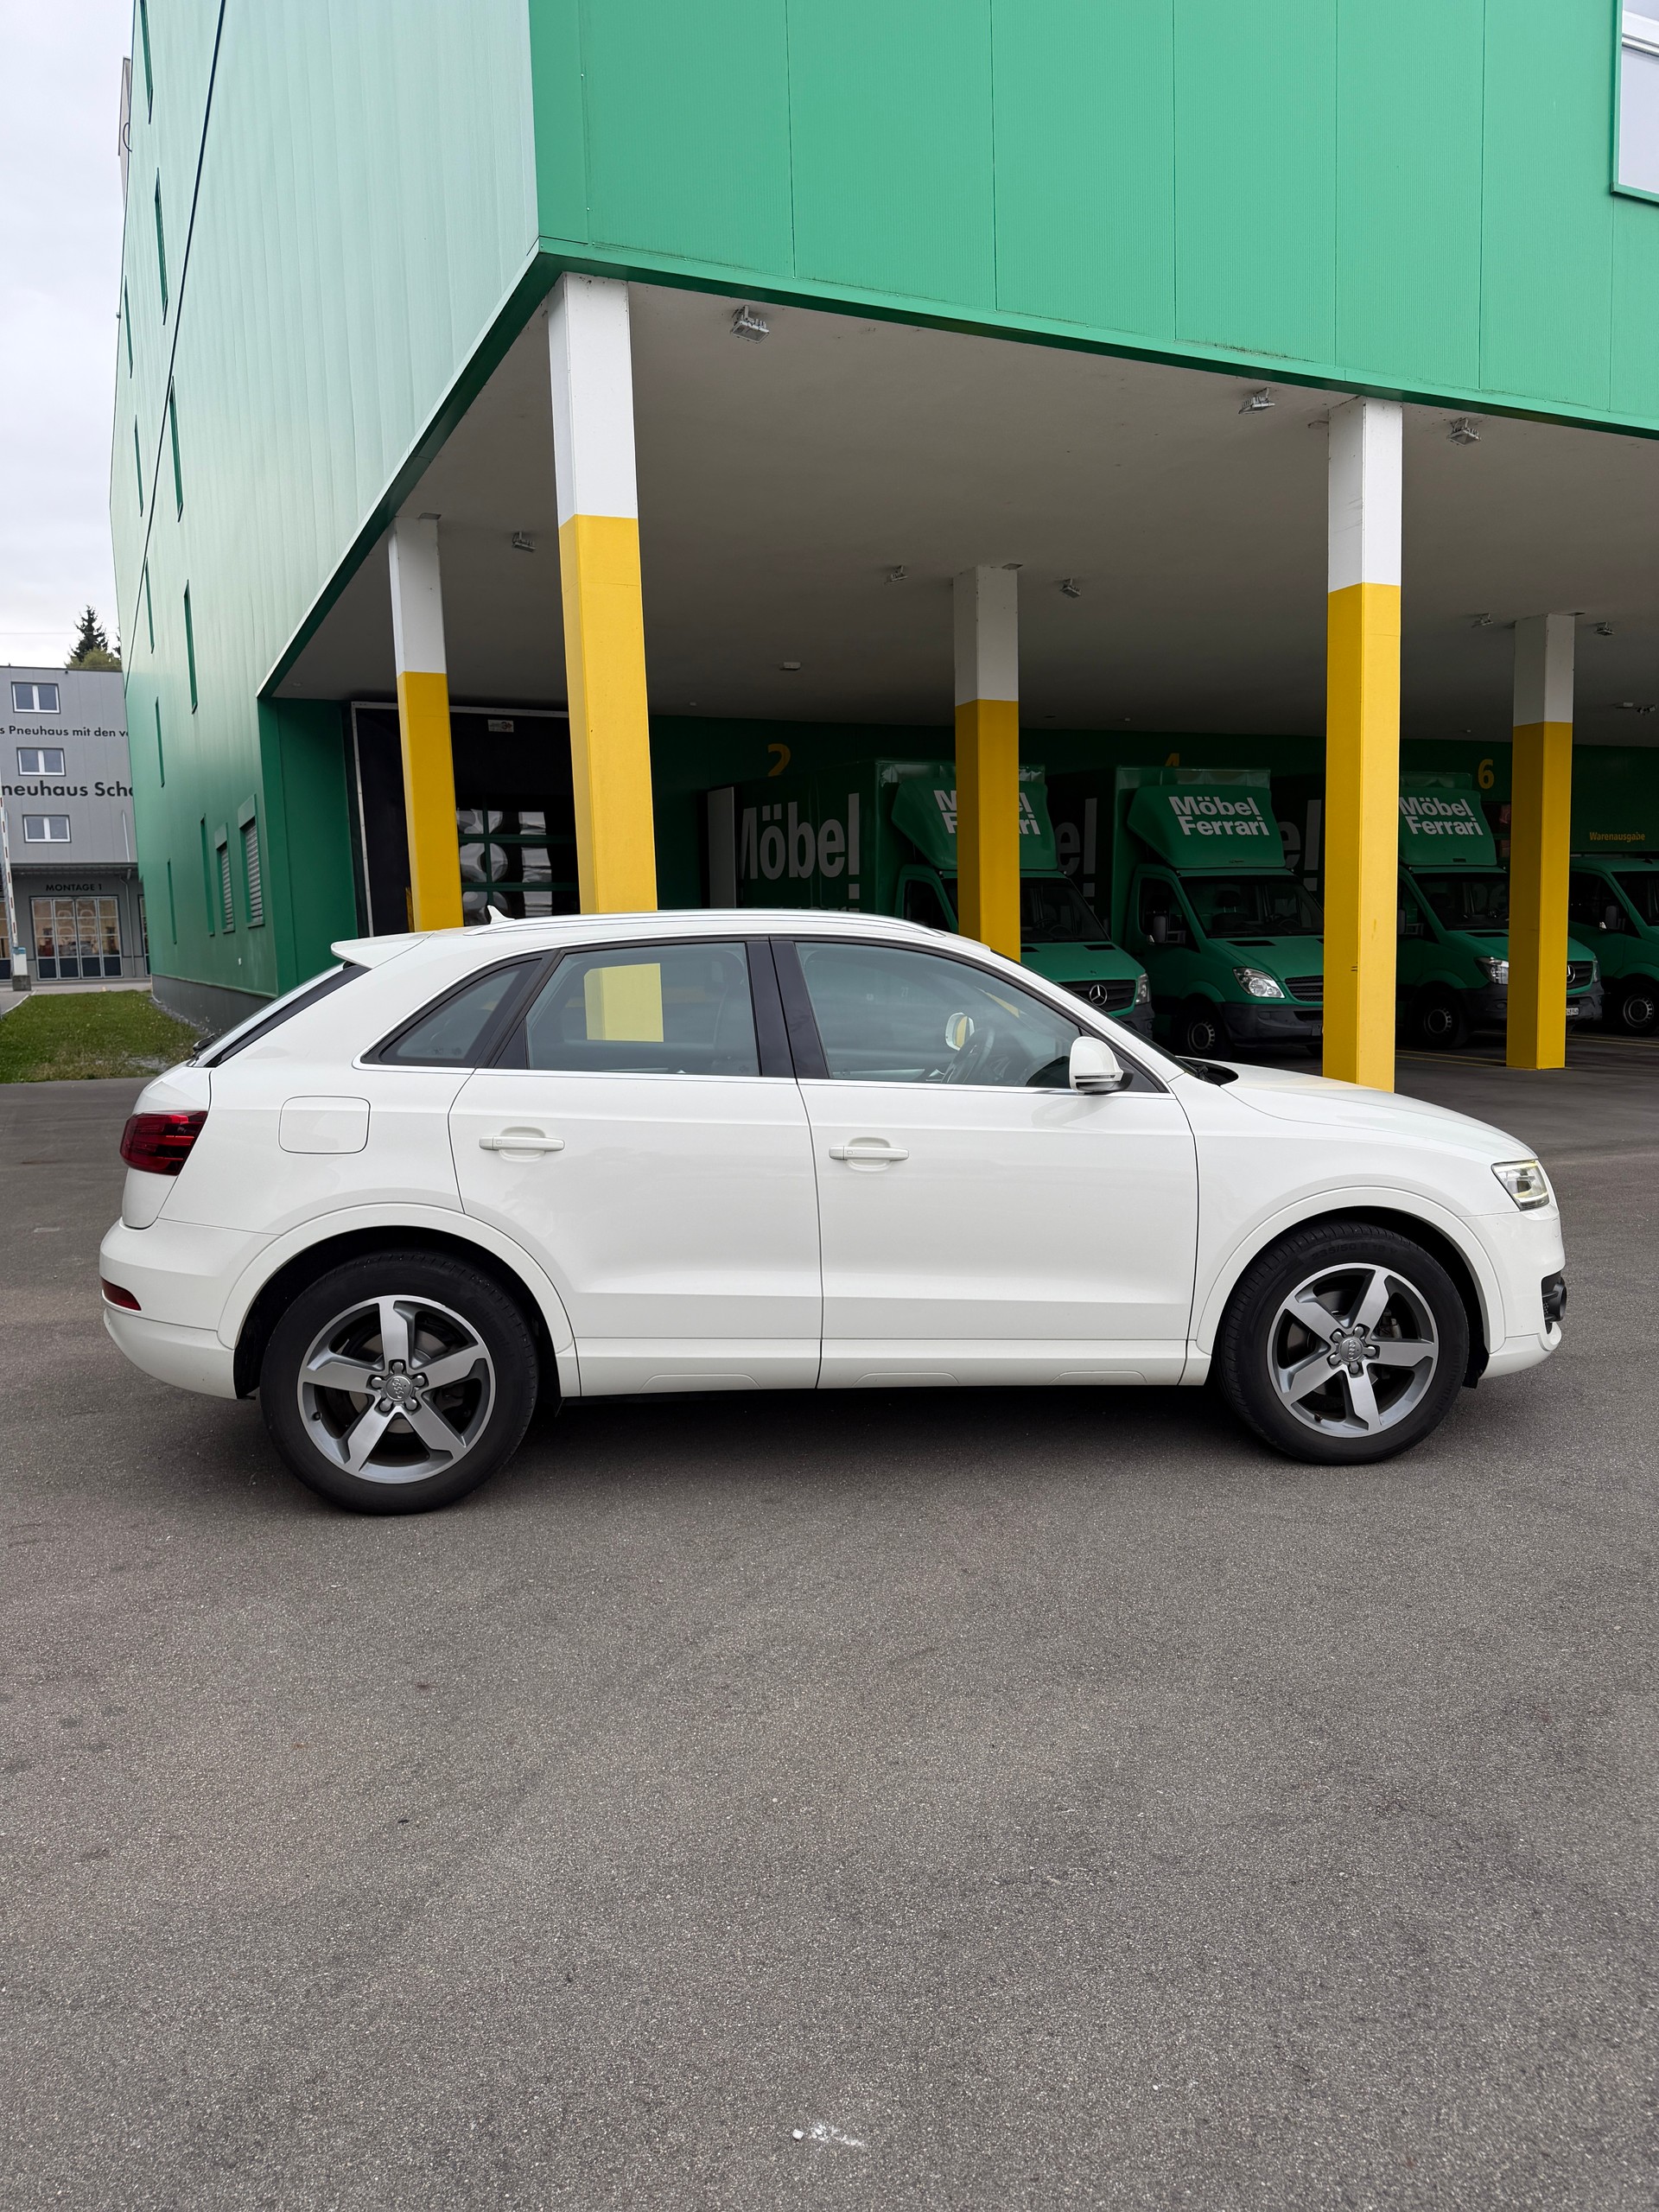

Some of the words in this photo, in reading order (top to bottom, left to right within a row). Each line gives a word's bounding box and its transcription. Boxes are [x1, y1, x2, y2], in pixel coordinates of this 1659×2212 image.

[9, 725, 69, 736] Pneuhaus
[73, 727, 91, 737] mit
[94, 728, 116, 737] den
[766, 742, 792, 779] 2
[1478, 758, 1495, 790] 6
[1168, 796, 1262, 817] Möbel
[1399, 796, 1474, 817] Möbel
[1177, 815, 1270, 836] Ferrari
[1405, 815, 1484, 836] Ferrari
[1589, 831, 1646, 843] Warenausgabe
[46, 883, 95, 892] MONTAGE
